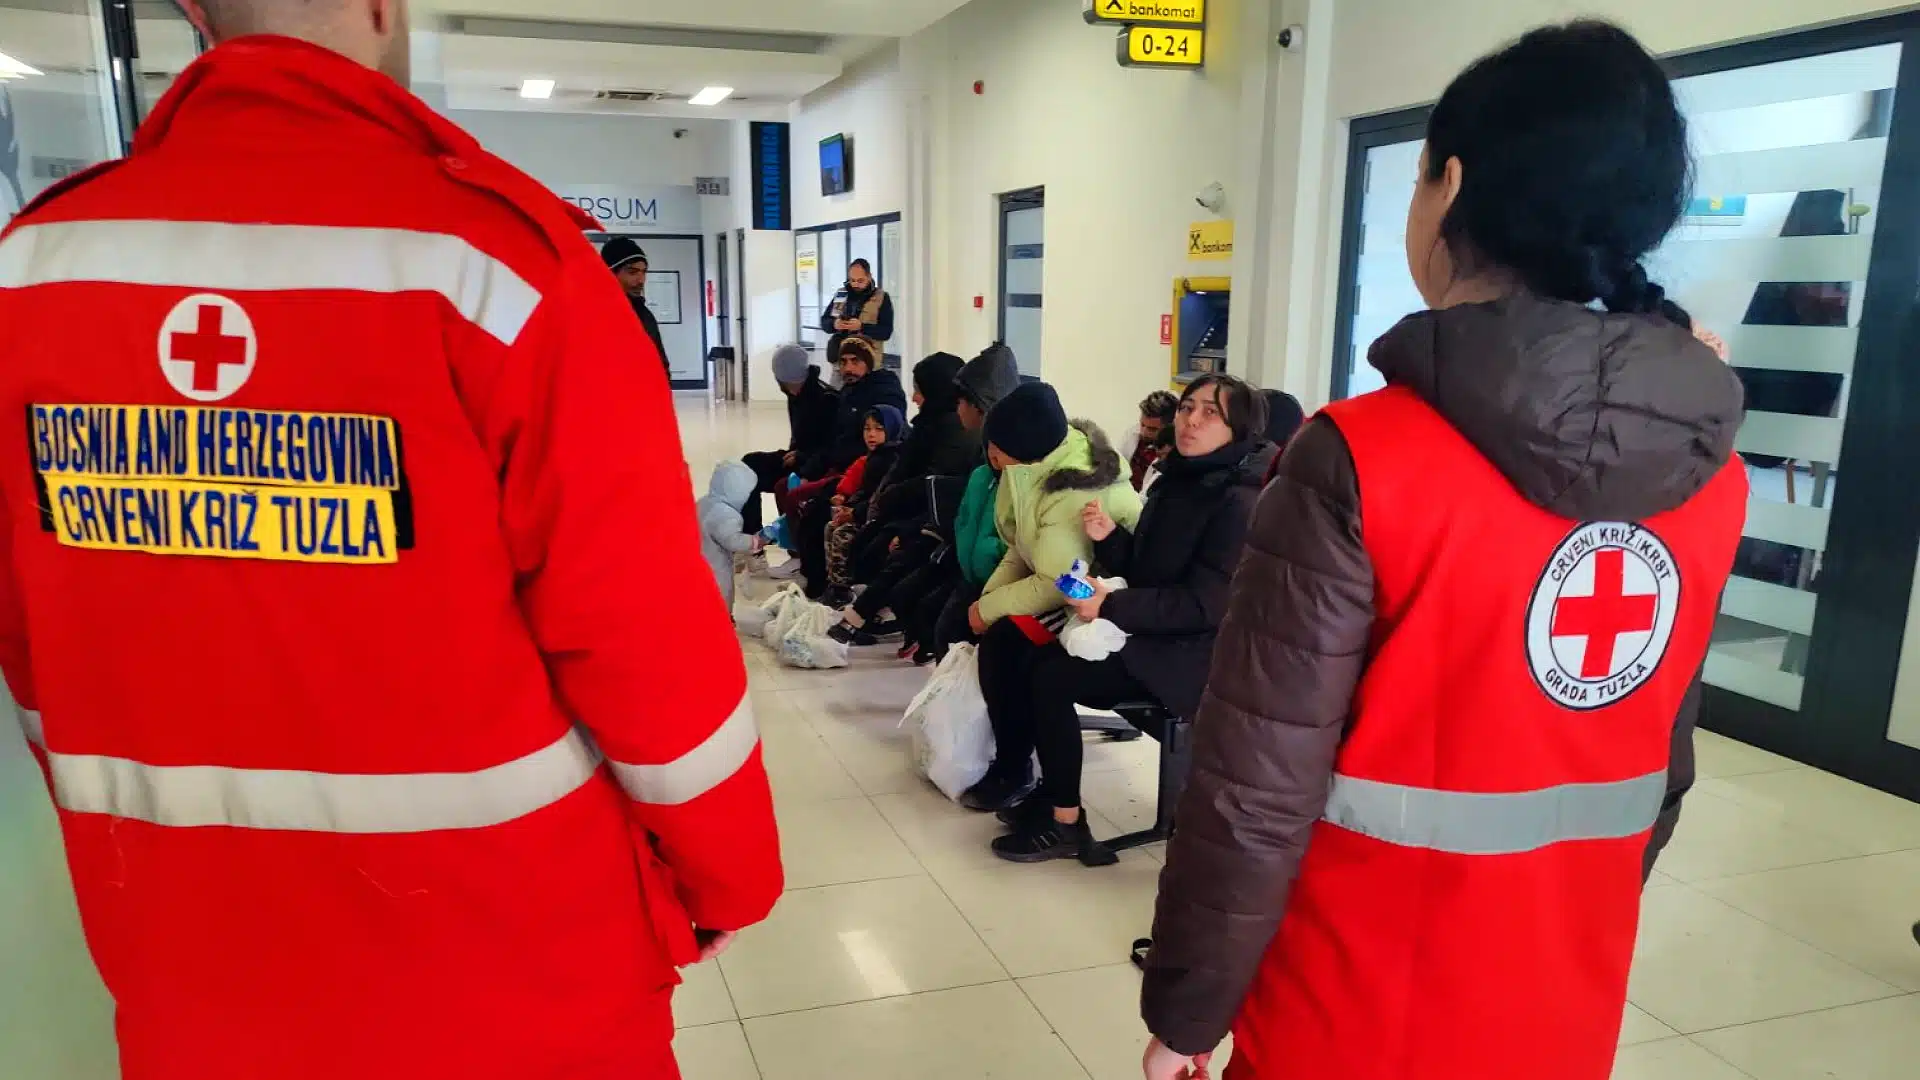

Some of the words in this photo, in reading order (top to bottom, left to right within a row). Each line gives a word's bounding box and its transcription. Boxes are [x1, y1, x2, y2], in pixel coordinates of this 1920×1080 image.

[1129, 1, 1195, 18] bankomat
[1142, 34, 1188, 56] 0-24
[562, 196, 657, 220] RSUM
[34, 405, 128, 474] BOSNIA
[136, 407, 189, 476] AND
[197, 408, 395, 487] HERZEGOVINA
[59, 484, 171, 546] CRVENI
[180, 489, 260, 552] KRIŽ
[271, 495, 387, 558] TUZLA
[1551, 531, 1595, 582] CRVENI
[1545, 667, 1588, 702] GRADA
[1597, 663, 1648, 700] TUZLA
